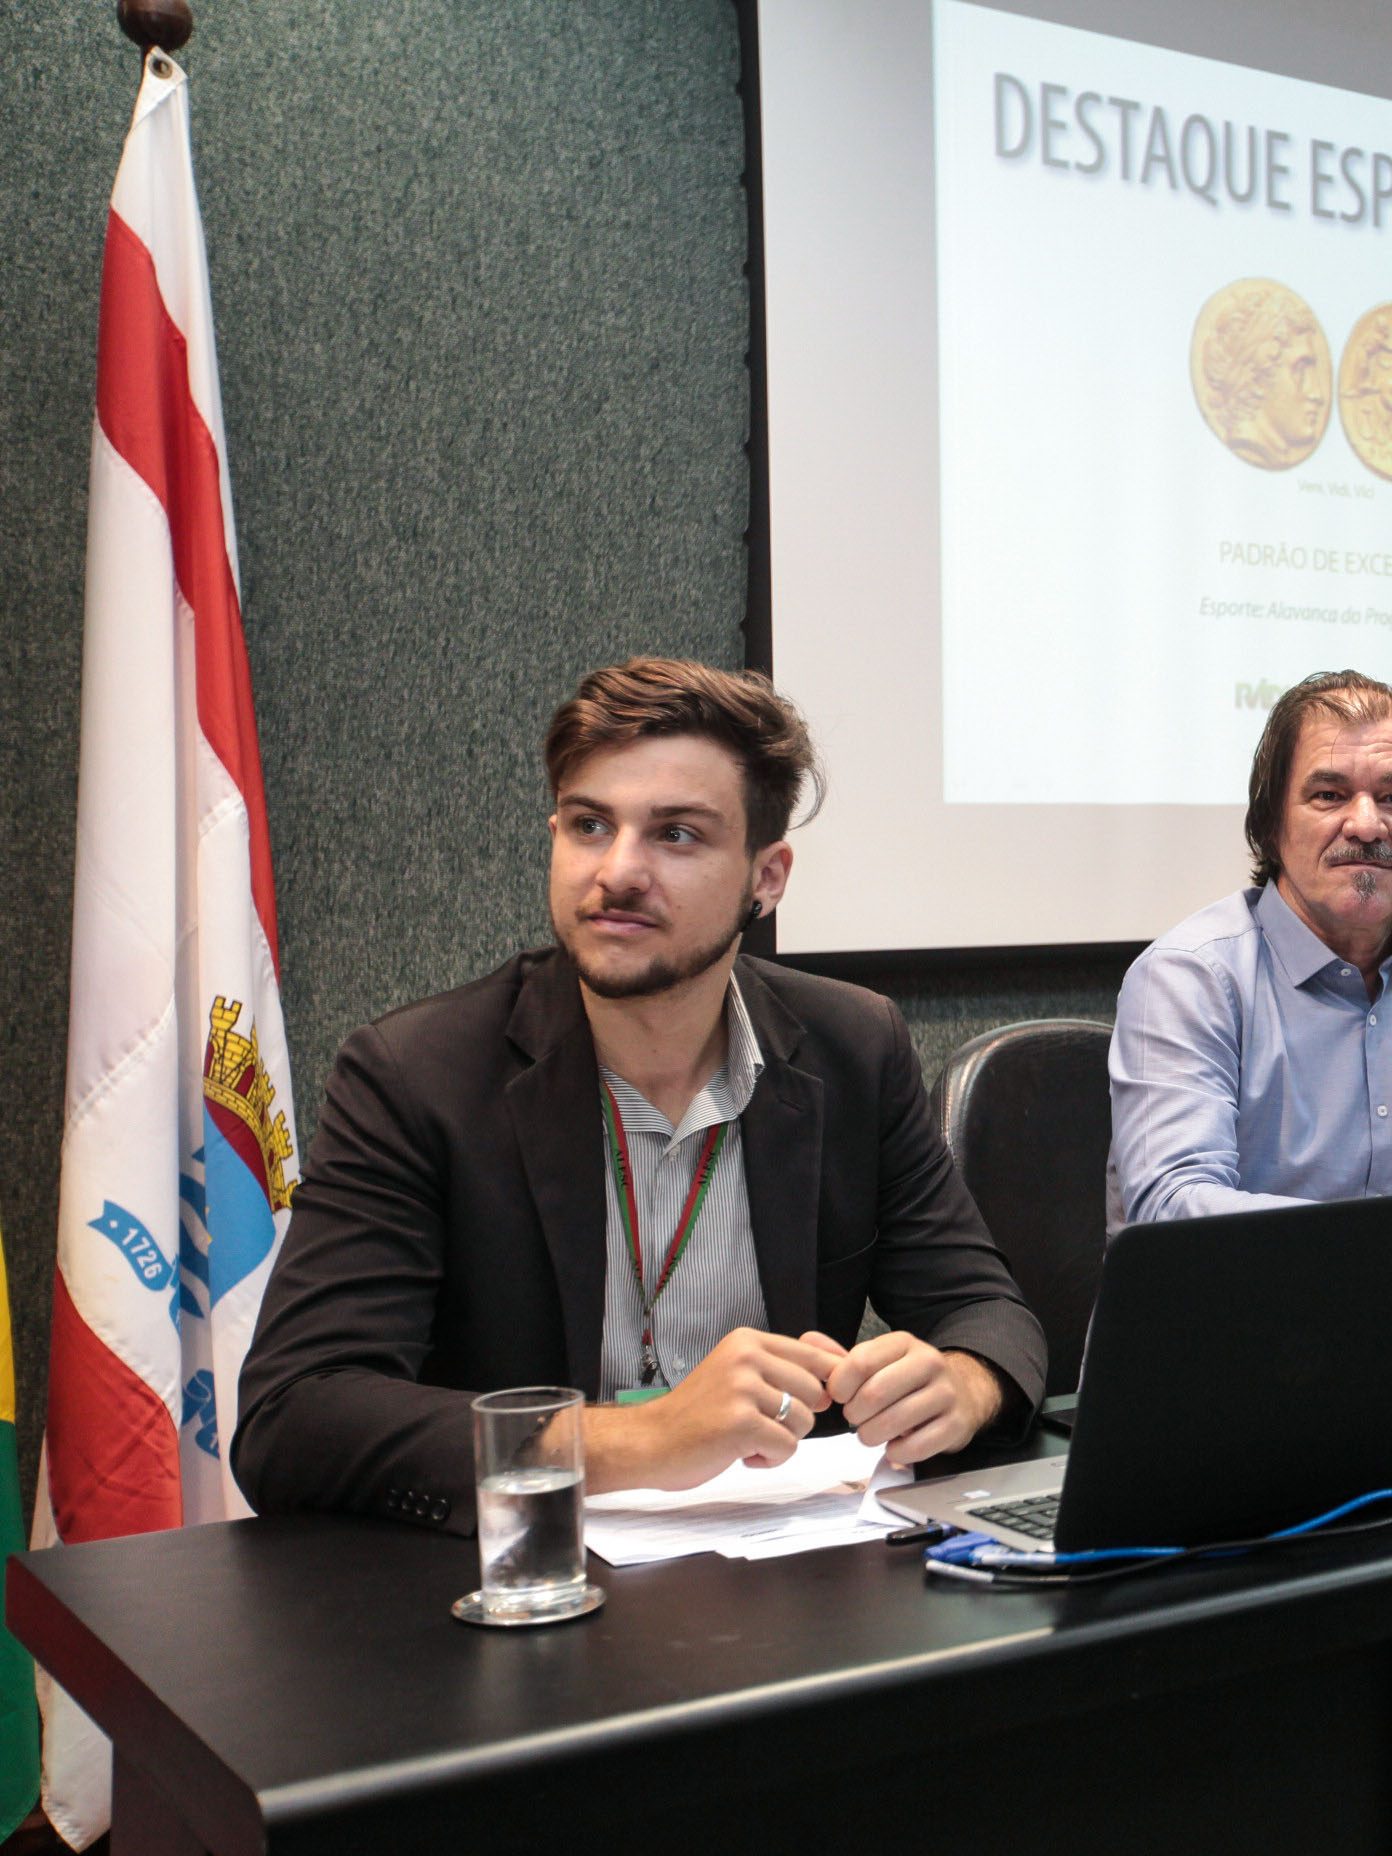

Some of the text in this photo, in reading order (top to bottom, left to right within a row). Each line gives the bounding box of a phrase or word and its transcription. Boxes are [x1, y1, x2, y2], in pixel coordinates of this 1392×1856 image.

[993, 73, 1293, 212] DESTAQUE
[1219, 541, 1307, 570] PADRÃO
[1313, 549, 1339, 573] DE
[1267, 601, 1337, 623] Alavanca
[1341, 605, 1361, 625] do
[121, 1228, 163, 1279] 1726
